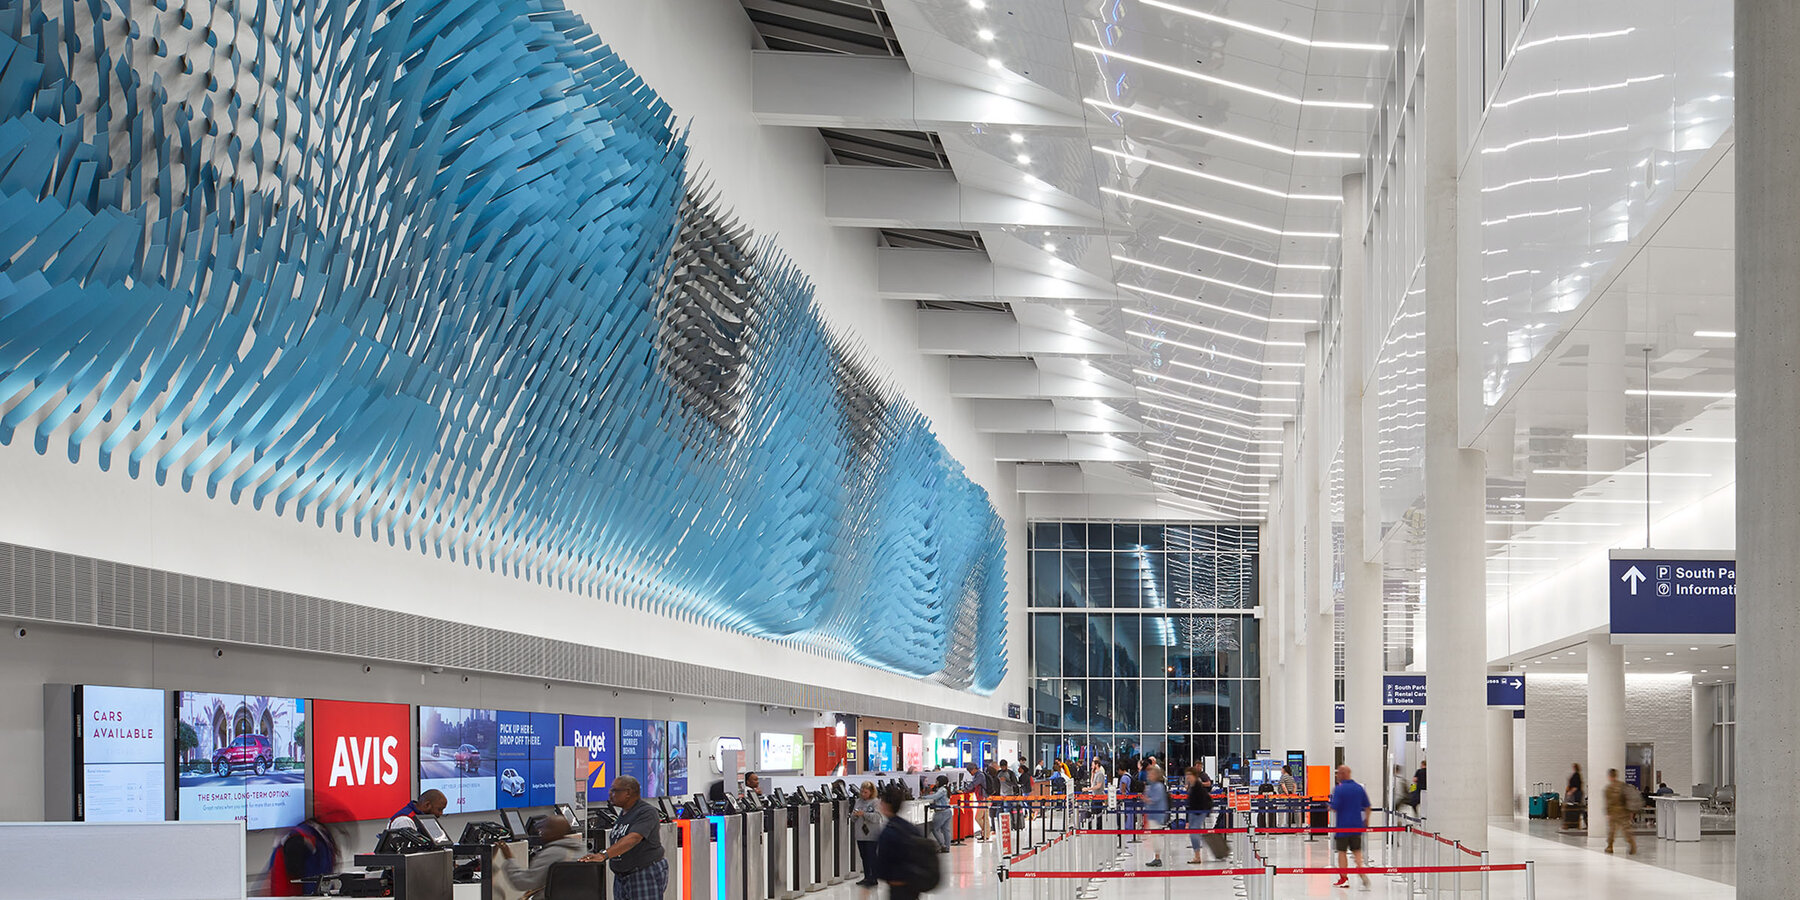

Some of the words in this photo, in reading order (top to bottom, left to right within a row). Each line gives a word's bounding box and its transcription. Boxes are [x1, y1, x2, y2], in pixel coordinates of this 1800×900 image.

[1676, 567, 1715, 579] South
[1718, 567, 1735, 579] Pa
[1676, 583, 1736, 595] Informati
[93, 710, 123, 722] CARS
[93, 728, 153, 739] AVAILABLE
[500, 723, 512, 734] PICK
[512, 724, 520, 734] UP
[622, 729, 633, 737] LEAVE
[633, 729, 643, 737] YOUR
[500, 735, 514, 745] DROP
[514, 735, 525, 745] OFF
[525, 736, 541, 746] THERE.
[574, 730, 606, 759] Budget
[622, 738, 639, 746] WORRIES
[329, 735, 398, 787] AVIS
[198, 794, 209, 802] THE
[234, 791, 267, 800] LONG-TERM
